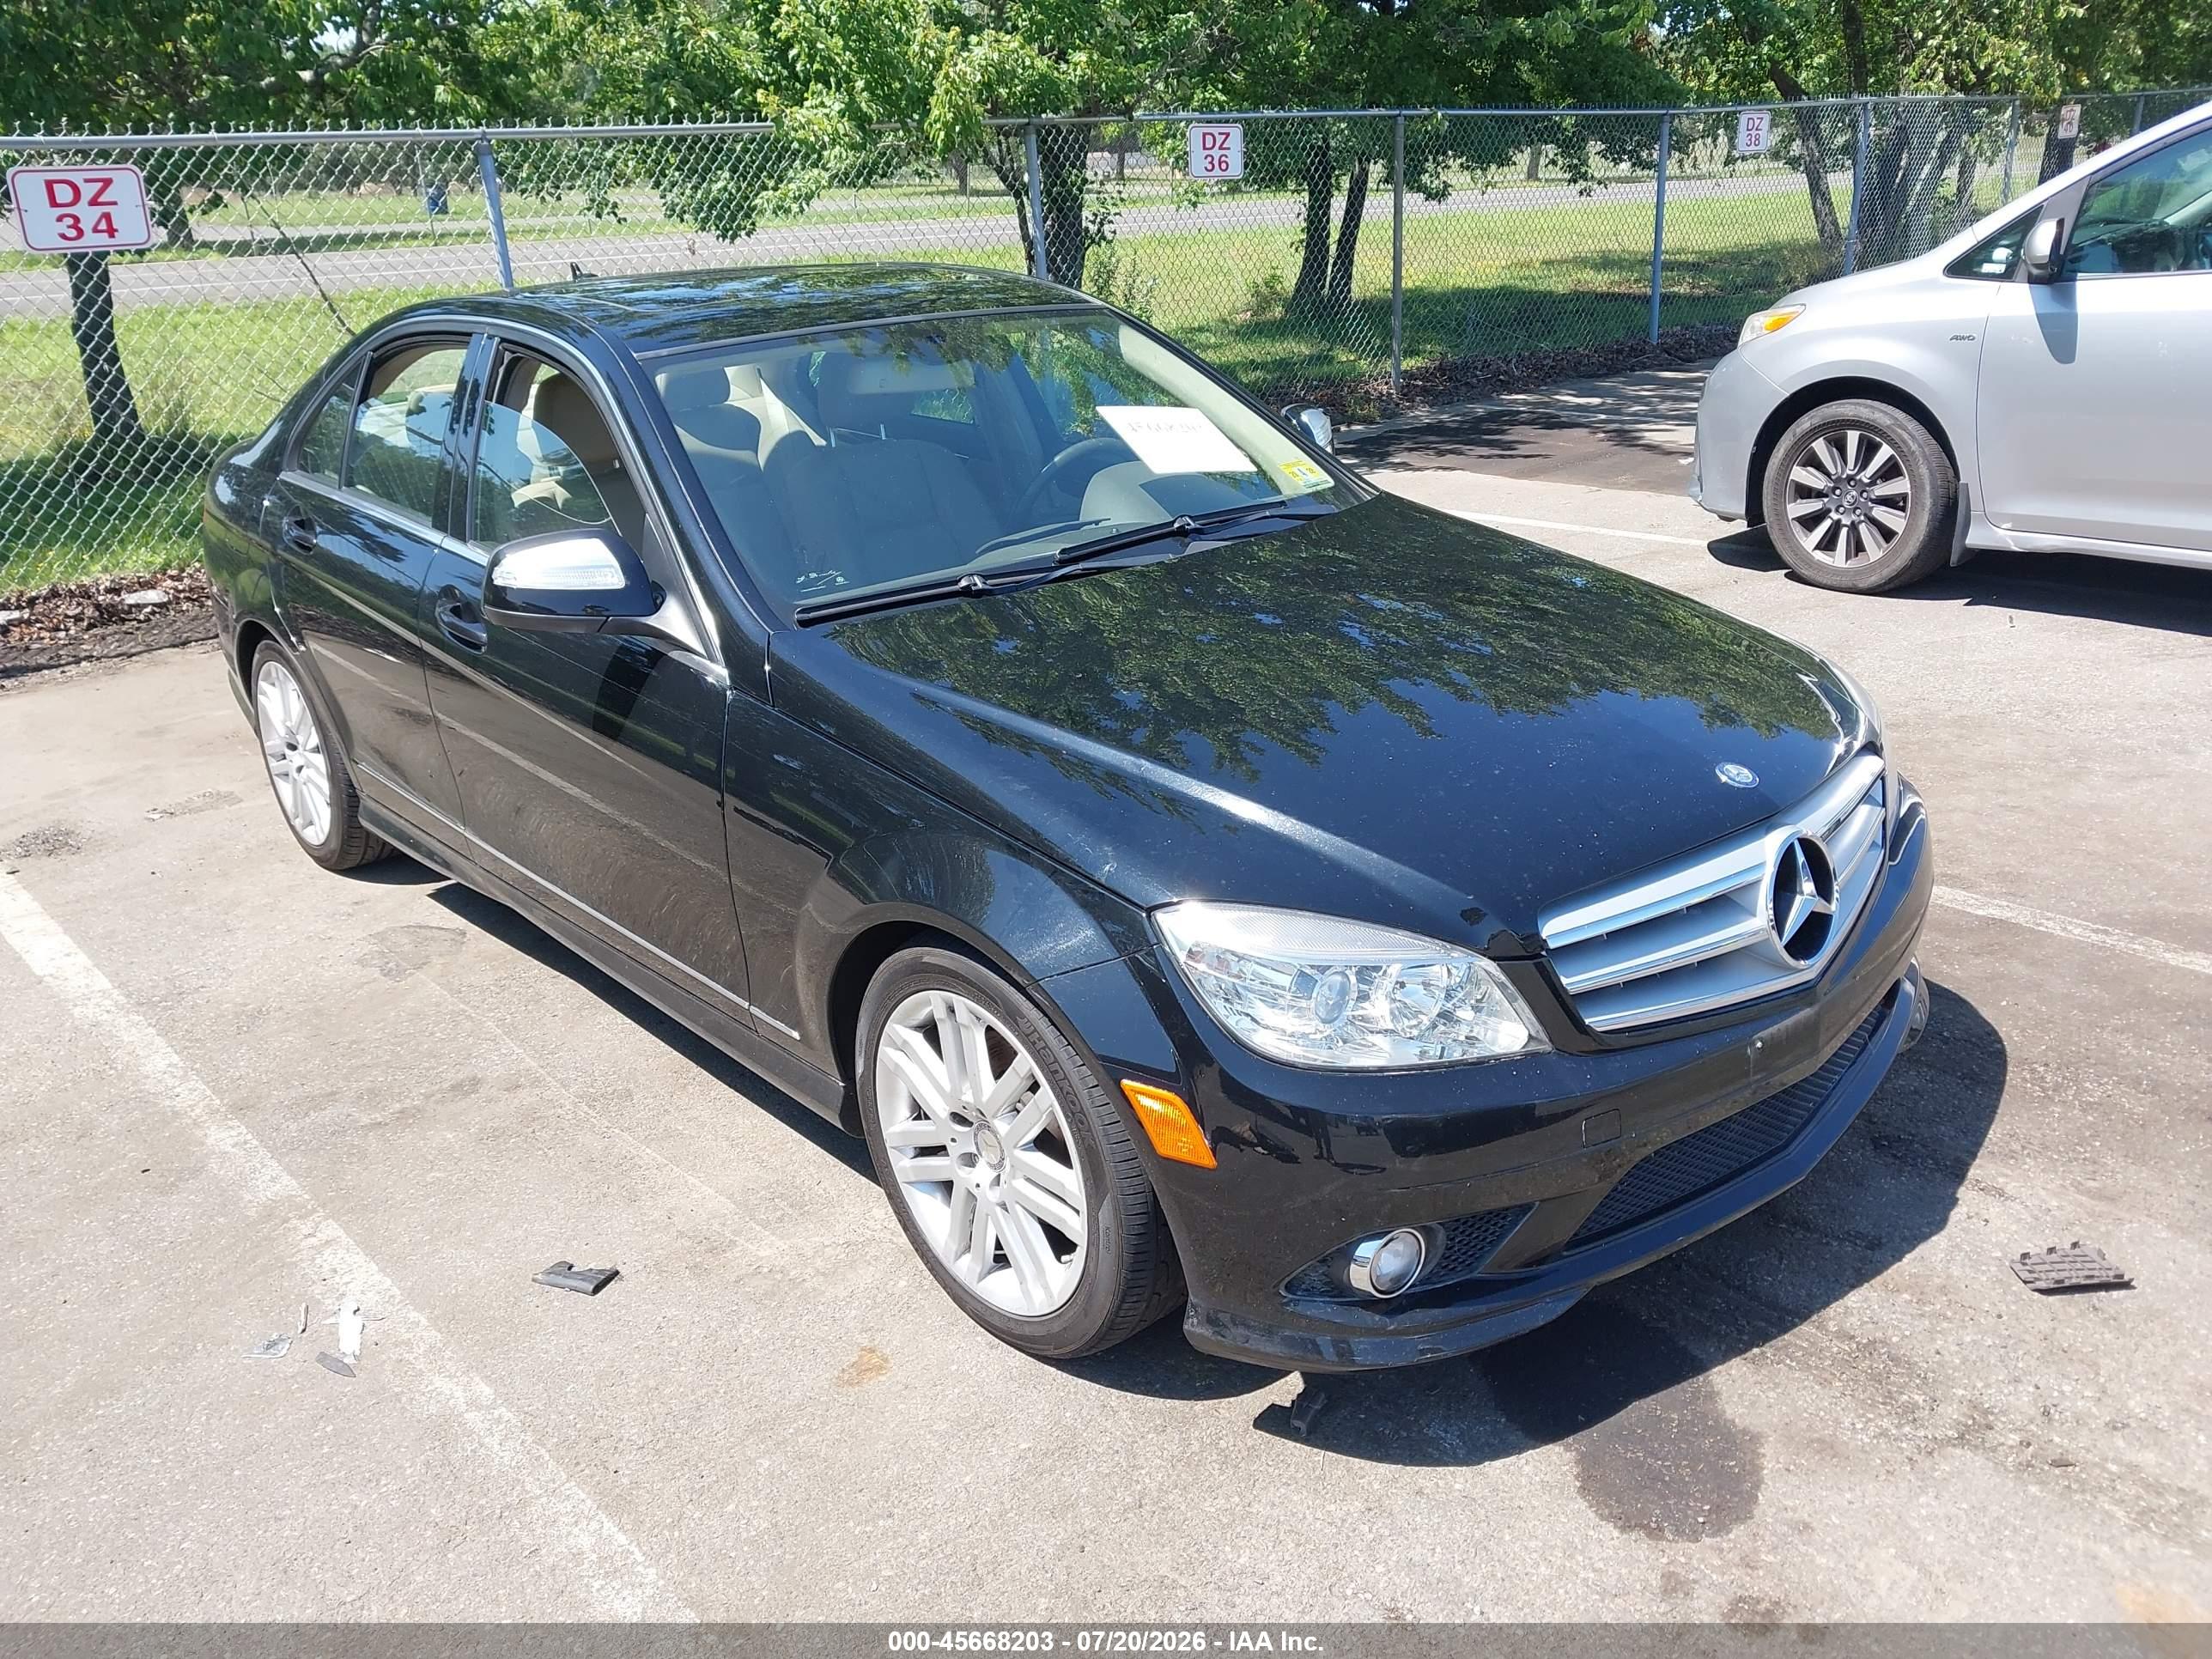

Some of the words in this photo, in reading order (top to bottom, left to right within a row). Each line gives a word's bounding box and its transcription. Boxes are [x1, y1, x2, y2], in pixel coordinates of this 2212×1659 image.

[1746, 117, 1764, 131] DZ
[1201, 131, 1231, 150] DZ
[1746, 133, 1760, 147] 38
[1204, 154, 1230, 172] 36
[44, 177, 118, 208] DZ
[55, 211, 118, 241] 34
